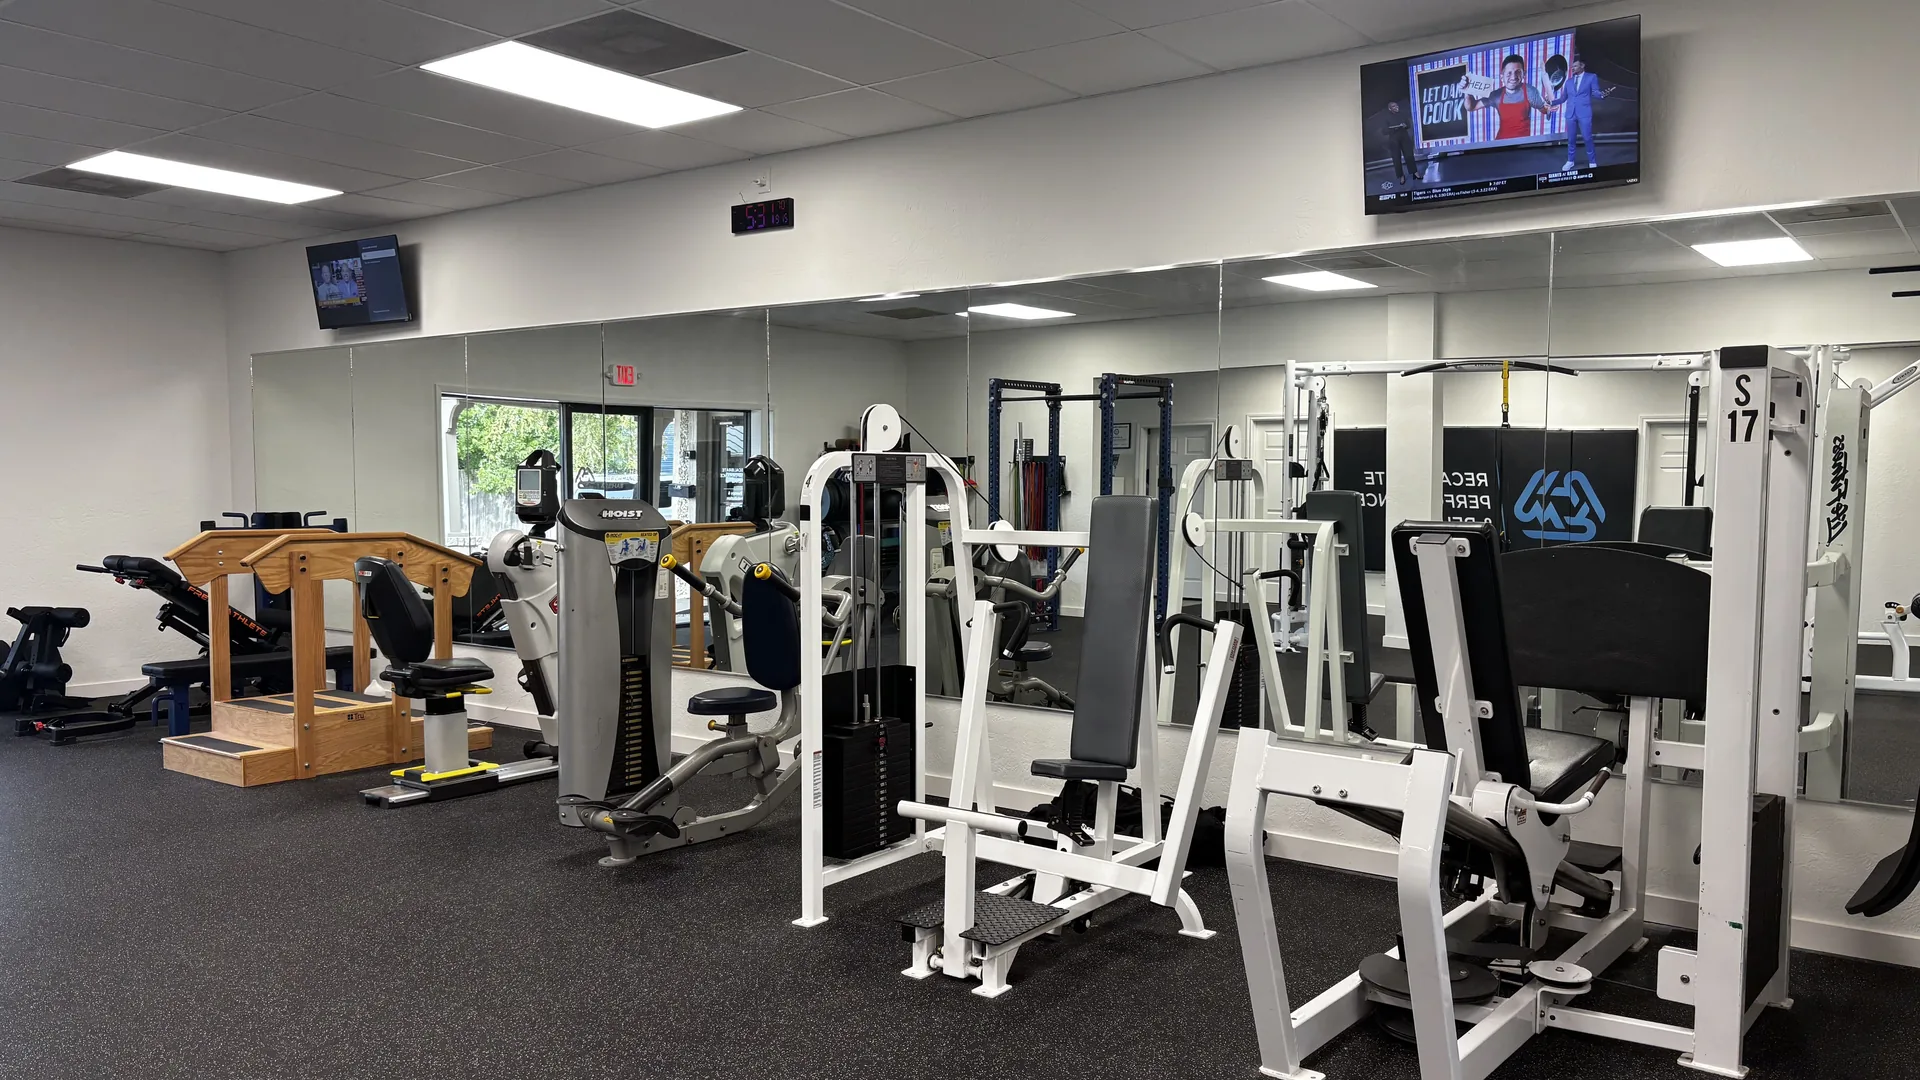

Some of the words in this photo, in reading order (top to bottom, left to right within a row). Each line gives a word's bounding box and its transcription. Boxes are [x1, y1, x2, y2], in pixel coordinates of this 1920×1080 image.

[1468, 79, 1491, 92] HELP
[1423, 86, 1441, 104] LET
[1422, 98, 1464, 125] COOK
[1379, 193, 1396, 201] ESPN
[1734, 374, 1751, 407] S
[1727, 409, 1759, 443] 17
[602, 510, 643, 518] HOIST
